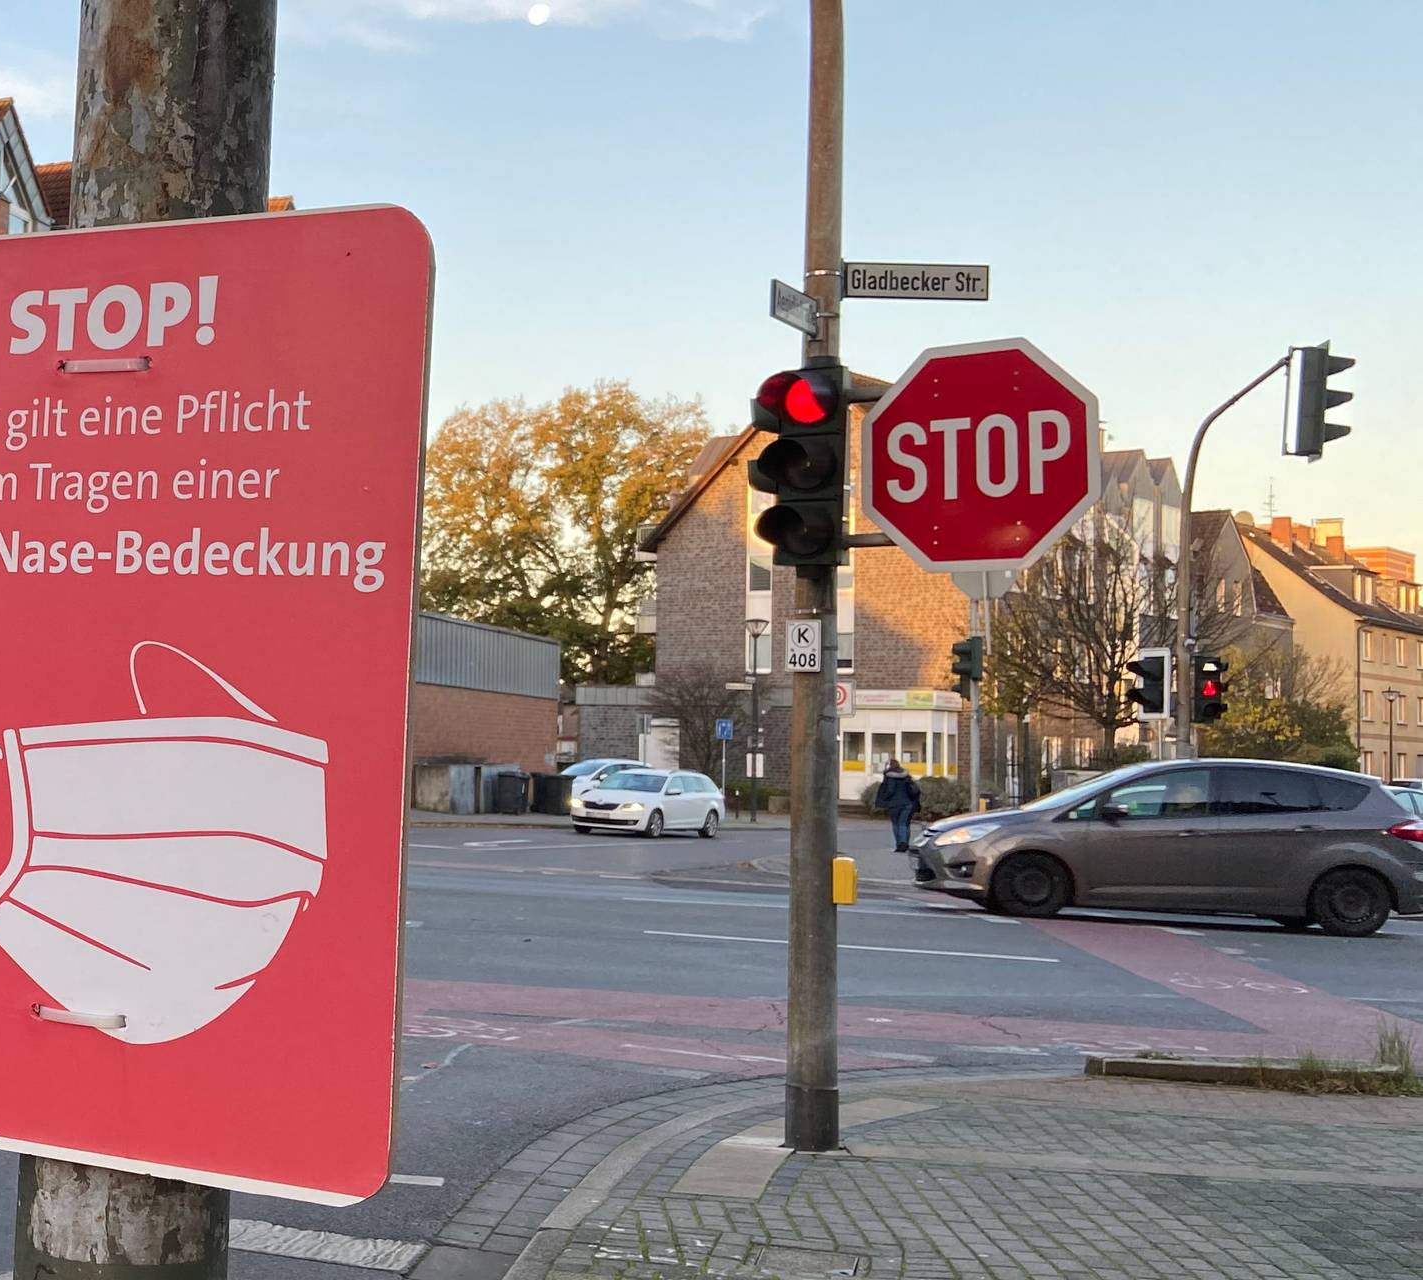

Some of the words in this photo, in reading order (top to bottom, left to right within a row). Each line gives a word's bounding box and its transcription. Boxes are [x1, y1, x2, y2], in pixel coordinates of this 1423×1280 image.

[851, 269, 951, 292] Gladbecker
[955, 271, 985, 293] Str.
[9, 275, 218, 354] STOP!
[5, 397, 68, 451] gilt
[80, 396, 162, 437] eine
[177, 389, 311, 434] Pflicht
[886, 409, 1072, 503] STOP
[30, 464, 158, 513] Tragen
[173, 458, 280, 499] einer
[789, 653, 817, 667] 408
[797, 628, 810, 644] K
